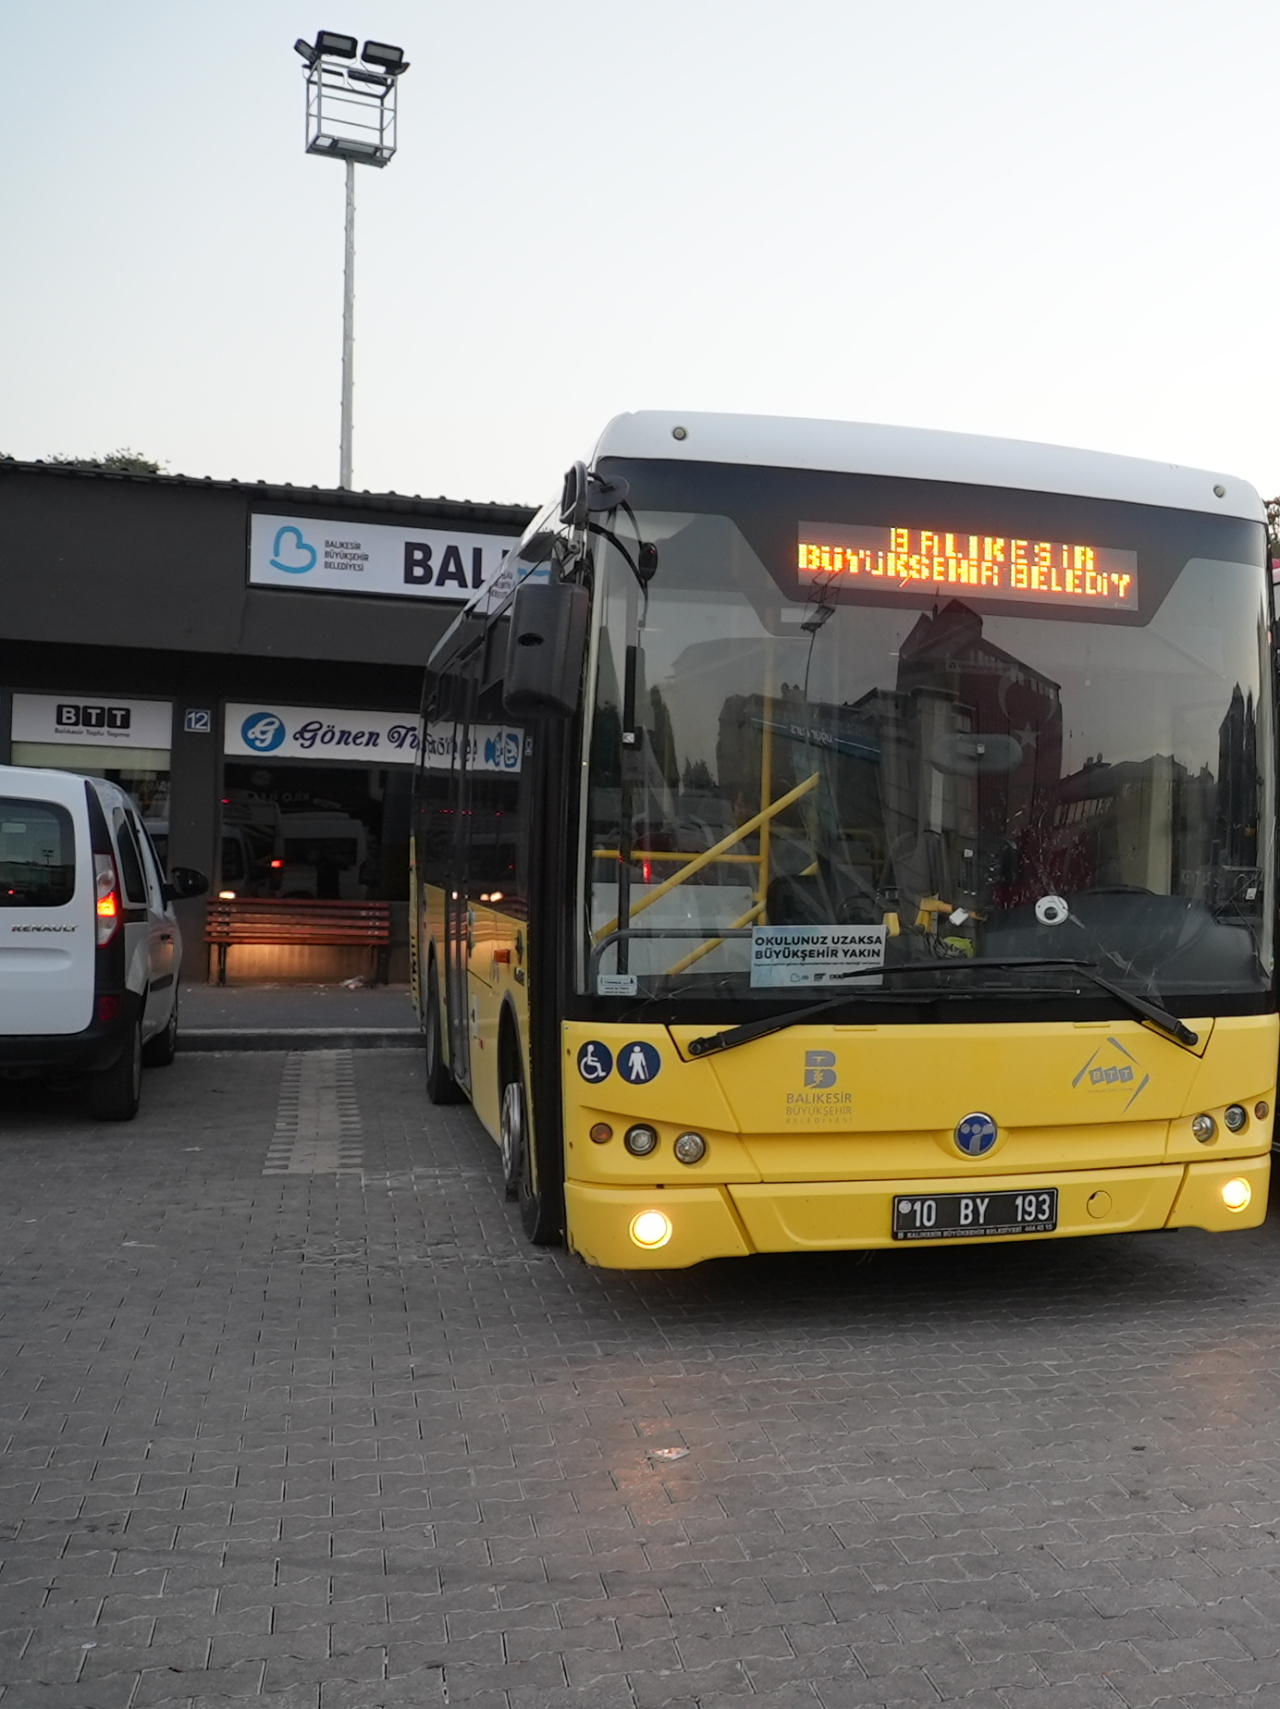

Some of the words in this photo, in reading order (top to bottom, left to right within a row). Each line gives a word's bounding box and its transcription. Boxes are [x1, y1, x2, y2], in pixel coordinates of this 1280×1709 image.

[403, 541, 512, 589] BAL
[60, 705, 128, 728] BTT
[187, 711, 209, 730] 12
[293, 720, 380, 749] Gönen
[11, 924, 78, 932] RENAULT
[755, 936, 828, 946] OKULUNUZ
[832, 935, 883, 945] UZAKSA
[755, 946, 838, 961] BÜYÜKŞEHİR
[842, 948, 881, 958] YAKIN
[786, 1091, 852, 1104] BALIKESİR
[786, 1104, 852, 1116] BÜYÜKŞEHİR
[913, 1200, 937, 1227] 10
[960, 1198, 990, 1225] BY
[1015, 1194, 1050, 1222] 193
